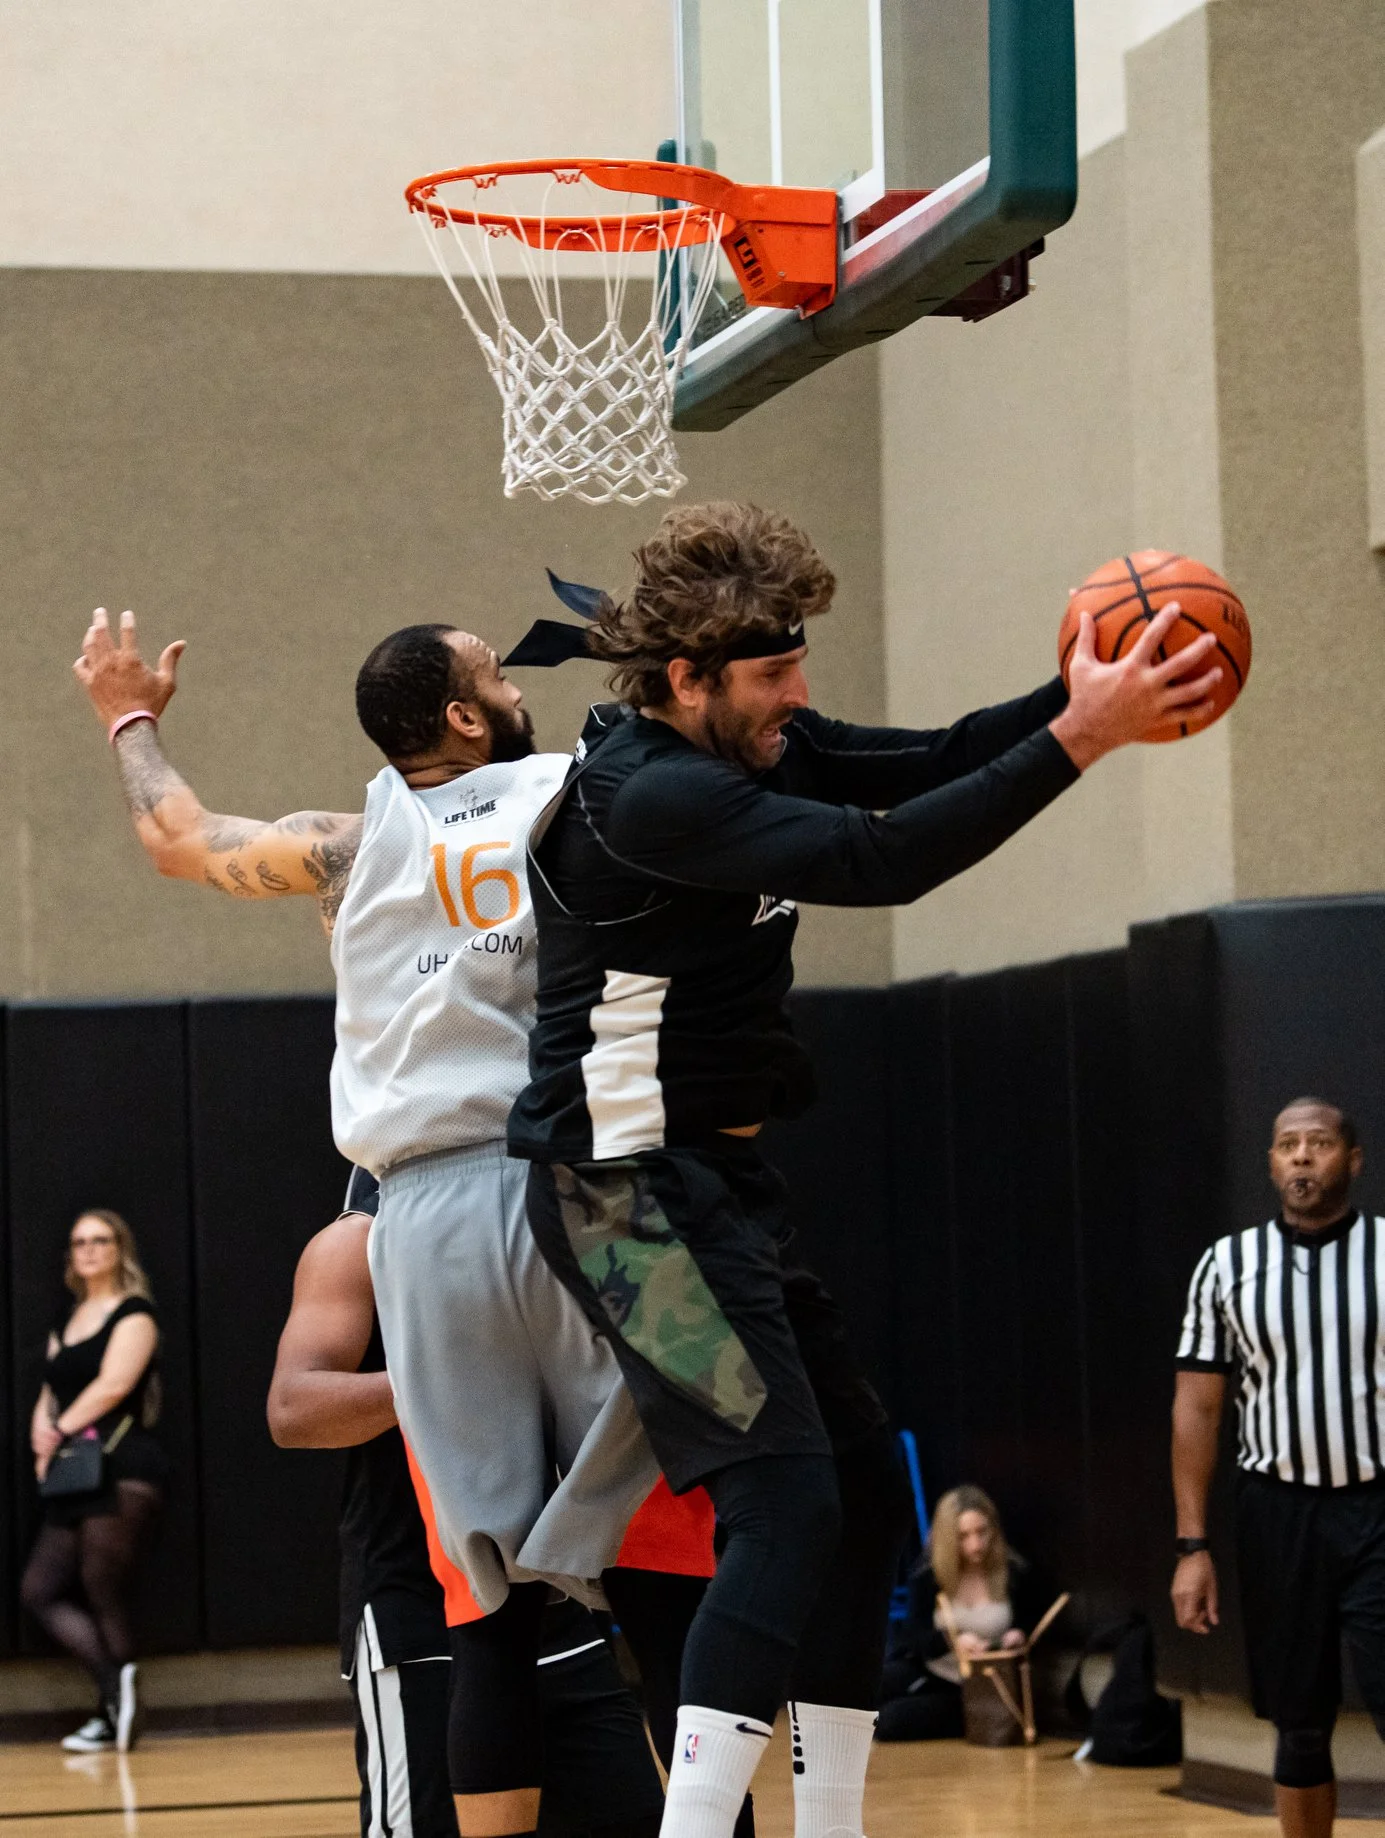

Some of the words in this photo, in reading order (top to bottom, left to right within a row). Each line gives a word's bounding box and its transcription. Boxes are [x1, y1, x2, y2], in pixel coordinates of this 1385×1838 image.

[444, 811, 467, 825] LIFE
[470, 800, 496, 818] TIME
[431, 842, 520, 929] 16
[417, 933, 522, 974] UH.COM
